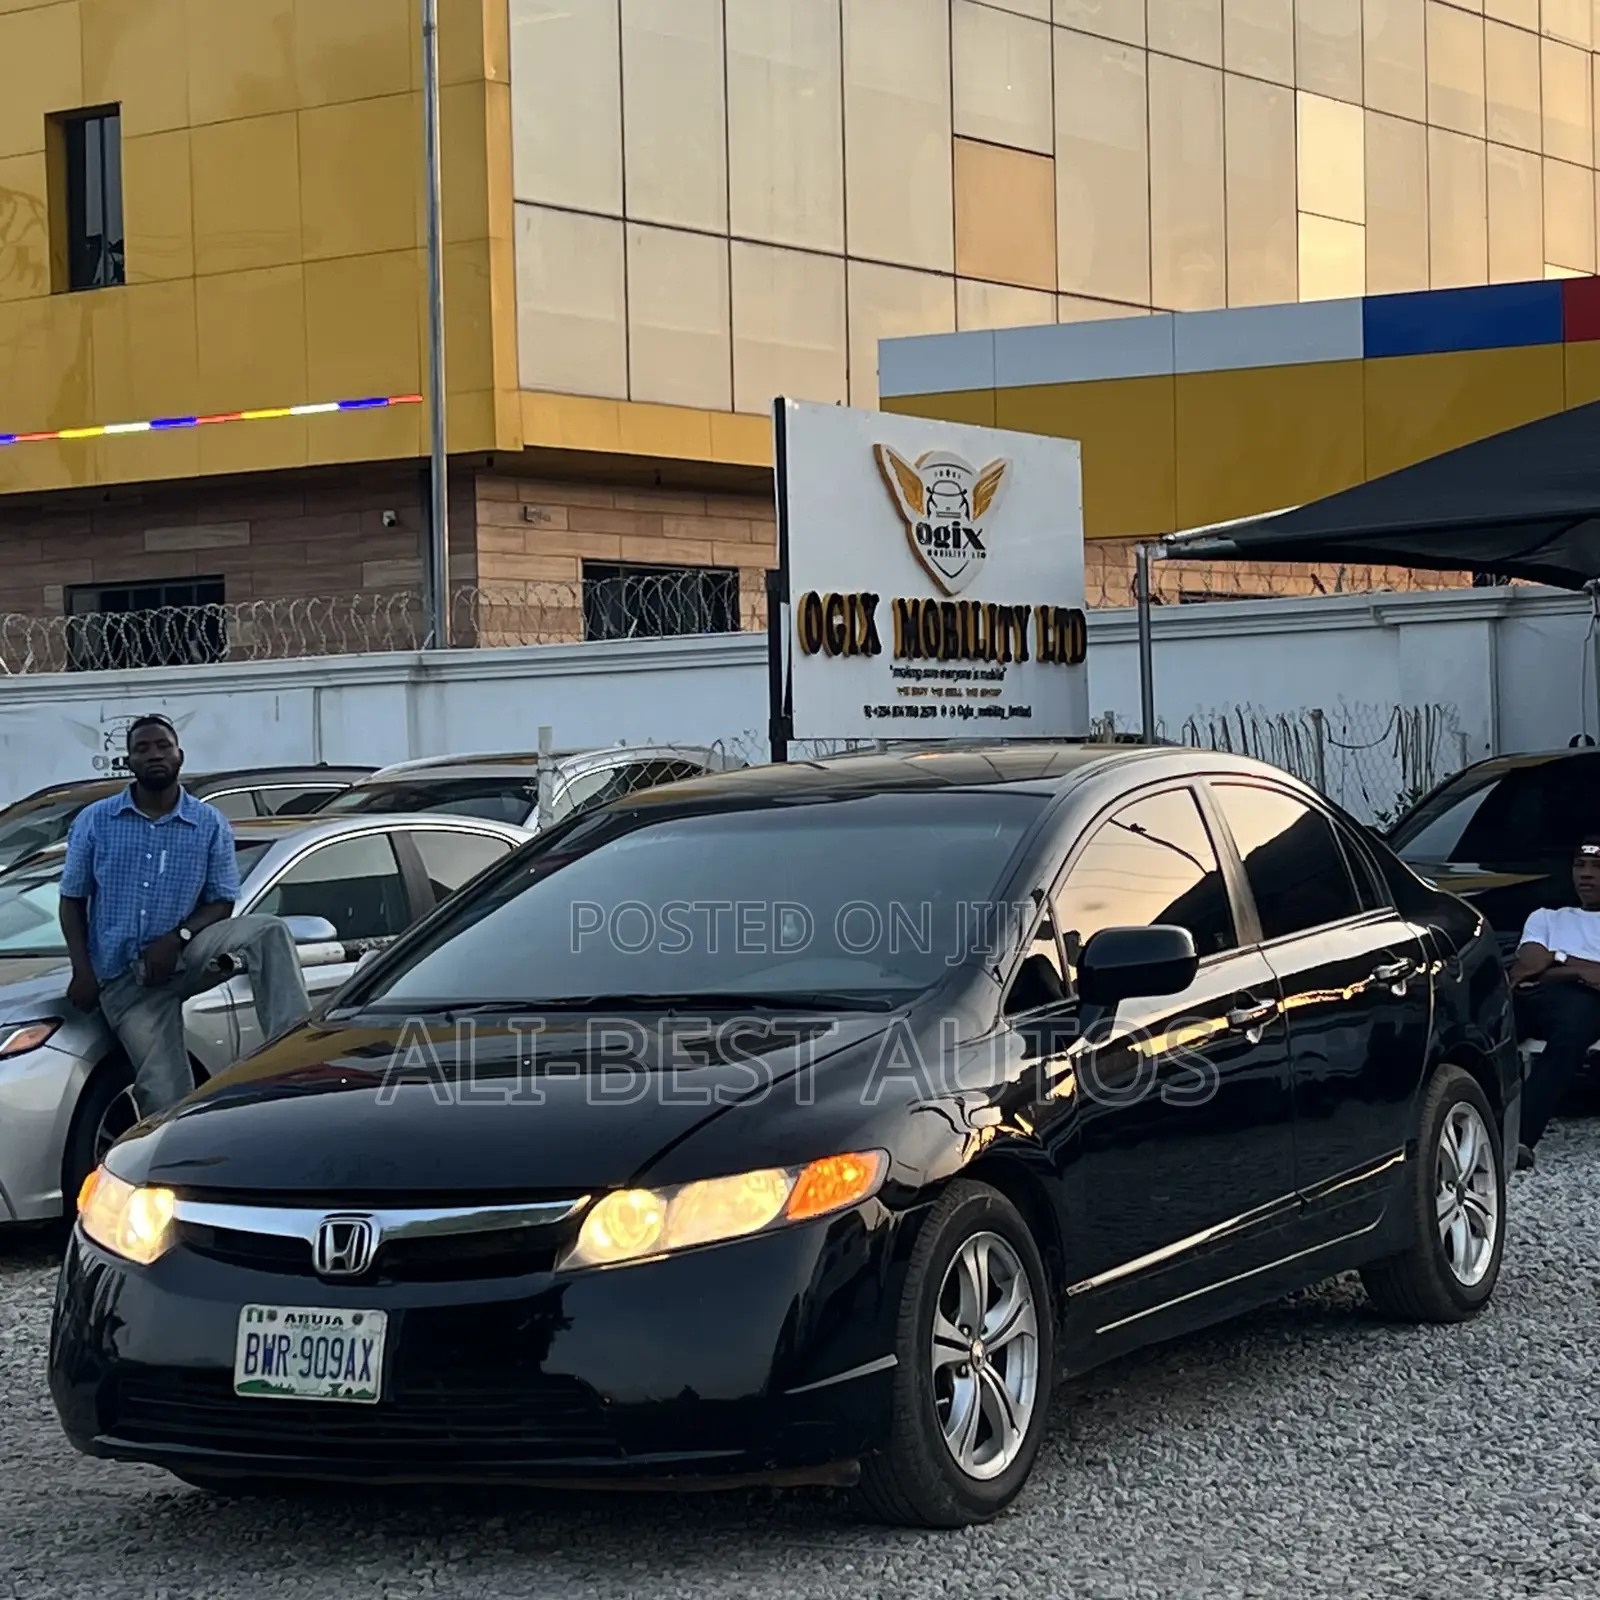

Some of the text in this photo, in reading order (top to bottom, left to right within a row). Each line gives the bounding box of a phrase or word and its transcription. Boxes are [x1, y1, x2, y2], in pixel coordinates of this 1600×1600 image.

[916, 521, 986, 549] Ogix
[798, 591, 1087, 665] OGIX MOBILITY LTD
[284, 1313, 344, 1326] ABUJA
